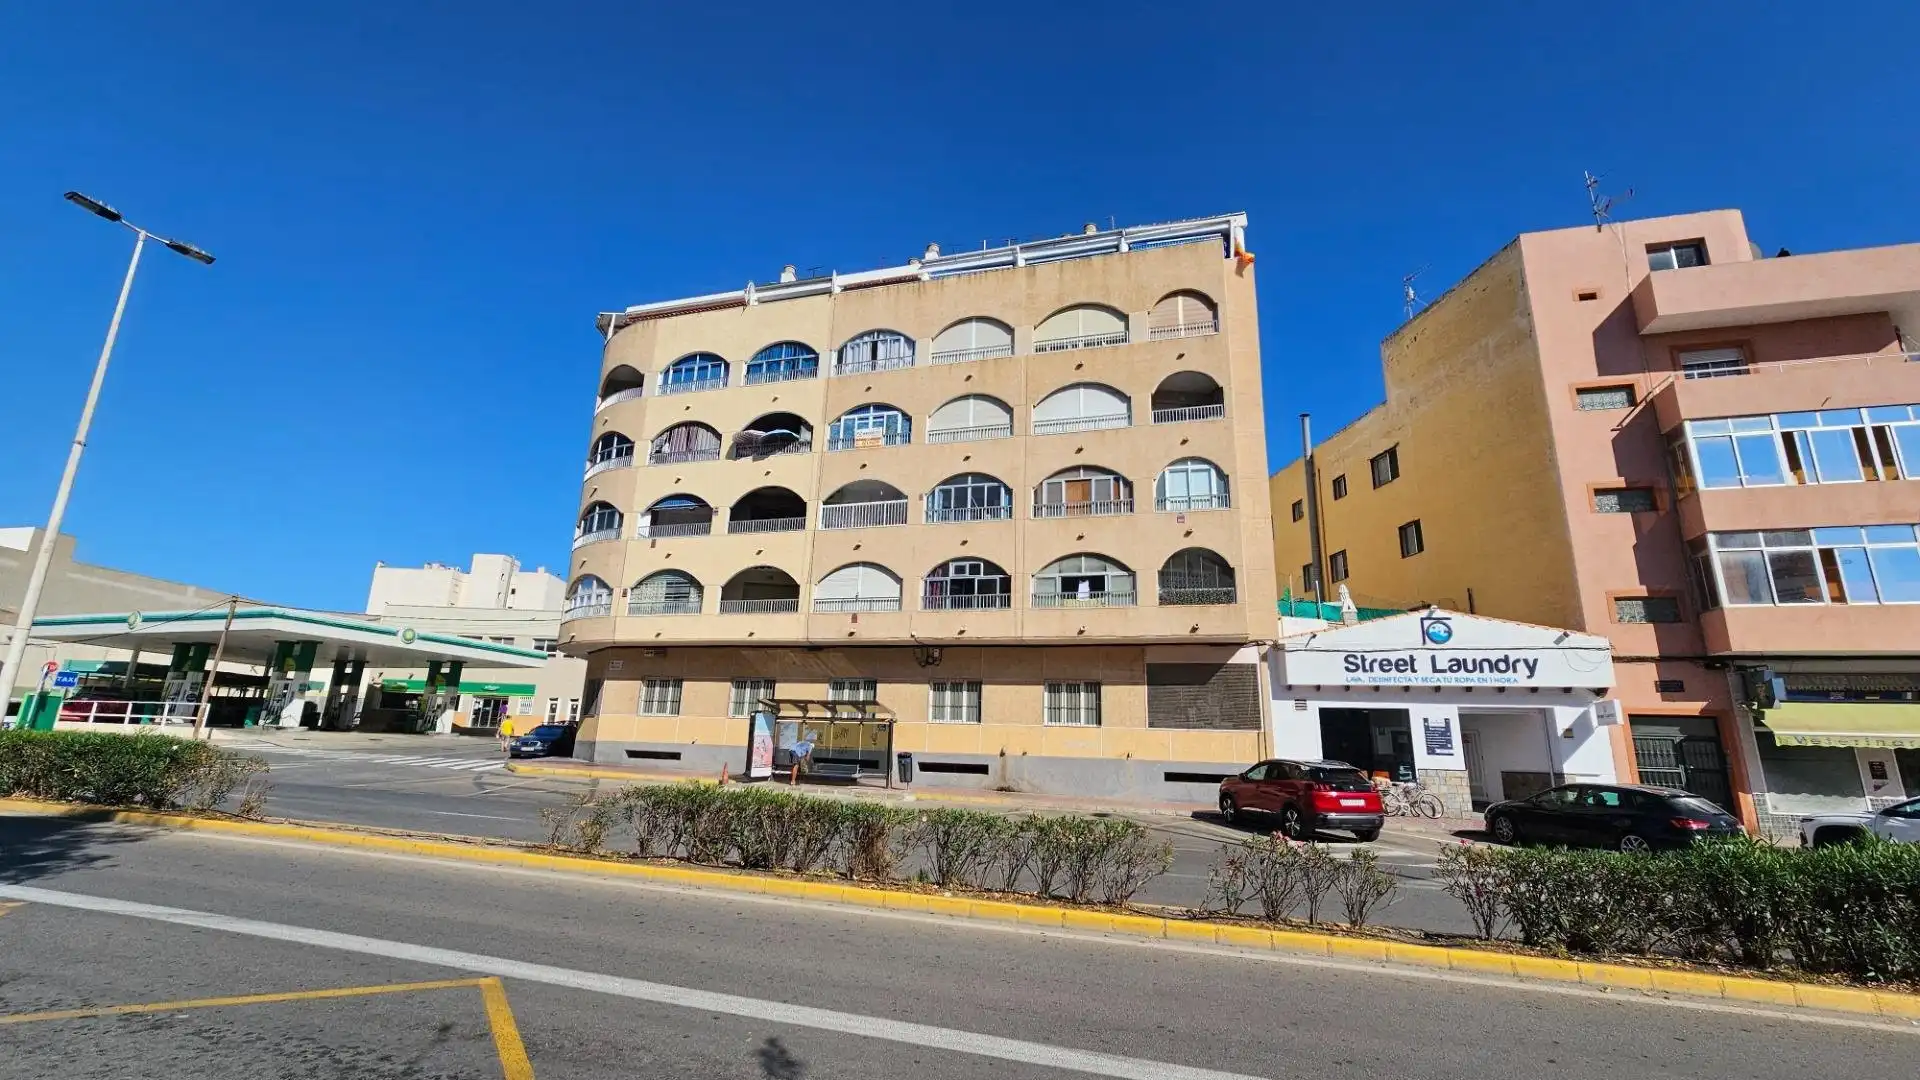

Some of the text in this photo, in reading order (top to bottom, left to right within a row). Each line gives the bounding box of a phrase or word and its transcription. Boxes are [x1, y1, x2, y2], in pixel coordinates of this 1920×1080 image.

[1343, 653, 1539, 680] Street Laundry
[1494, 676, 1519, 684] HORA
